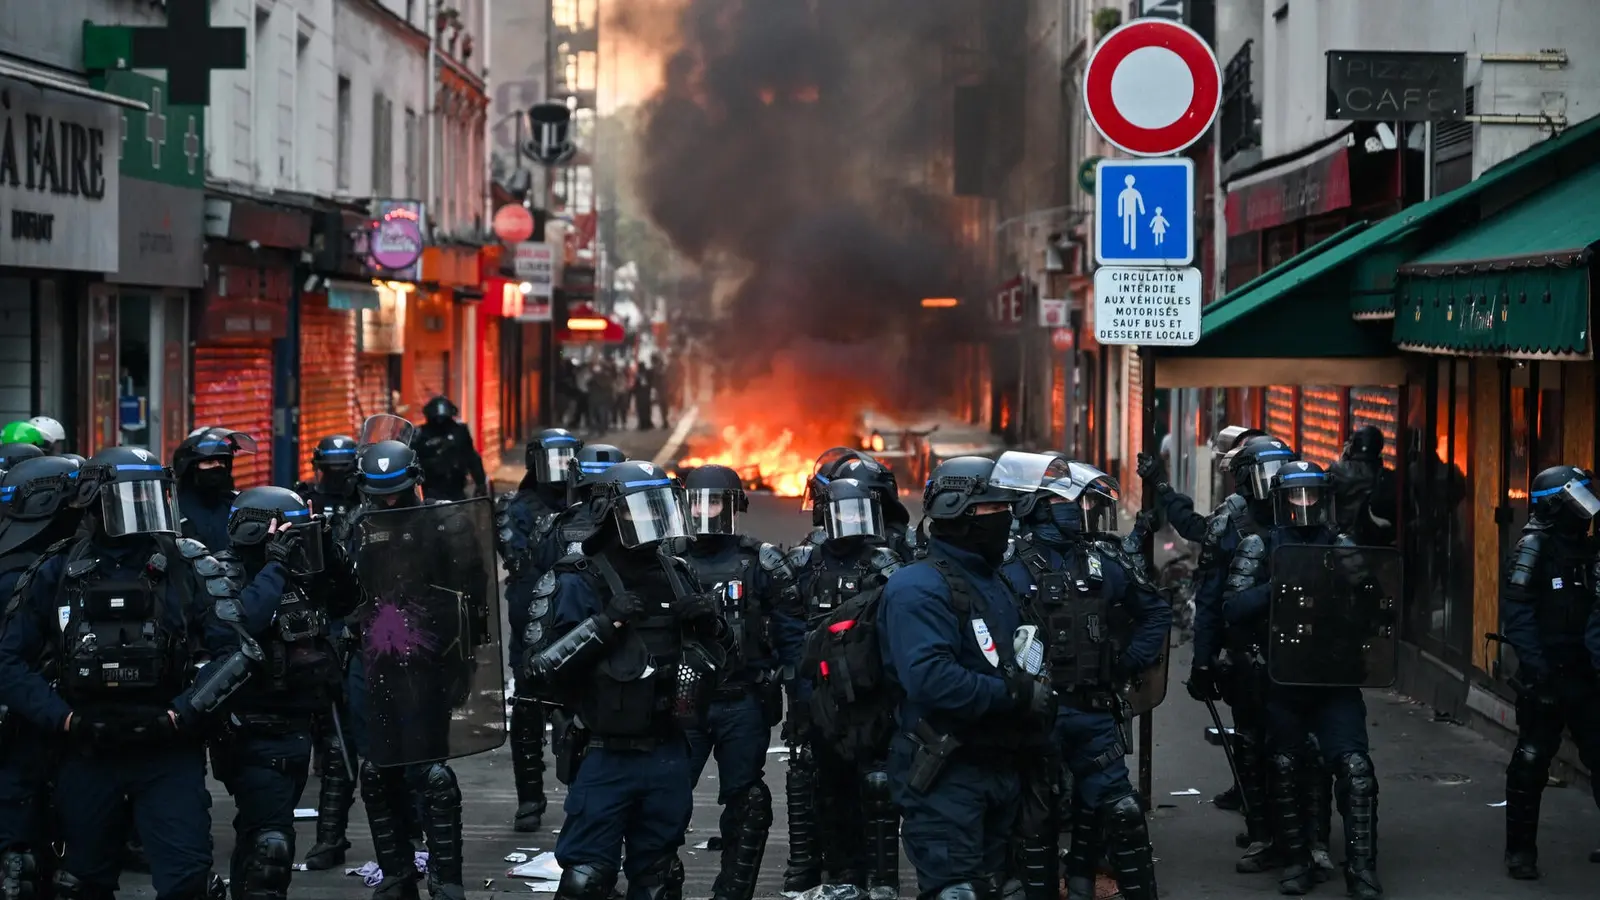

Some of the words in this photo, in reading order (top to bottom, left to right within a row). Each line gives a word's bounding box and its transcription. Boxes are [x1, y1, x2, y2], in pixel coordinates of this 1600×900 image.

[25, 112, 106, 201] FAIRE
[1112, 272, 1184, 282] CIRCULATION
[1119, 284, 1176, 294] INTERDITE
[1104, 296, 1125, 304] AUX
[1130, 295, 1191, 305] VÉHICULES
[1116, 306, 1179, 317] MOTORISÉS
[1113, 318, 1141, 328] SAUF
[1144, 319, 1166, 328] BUS
[1169, 319, 1182, 328] ET
[1100, 330, 1152, 339] DESSERTE
[1156, 331, 1194, 340] LOCALE
